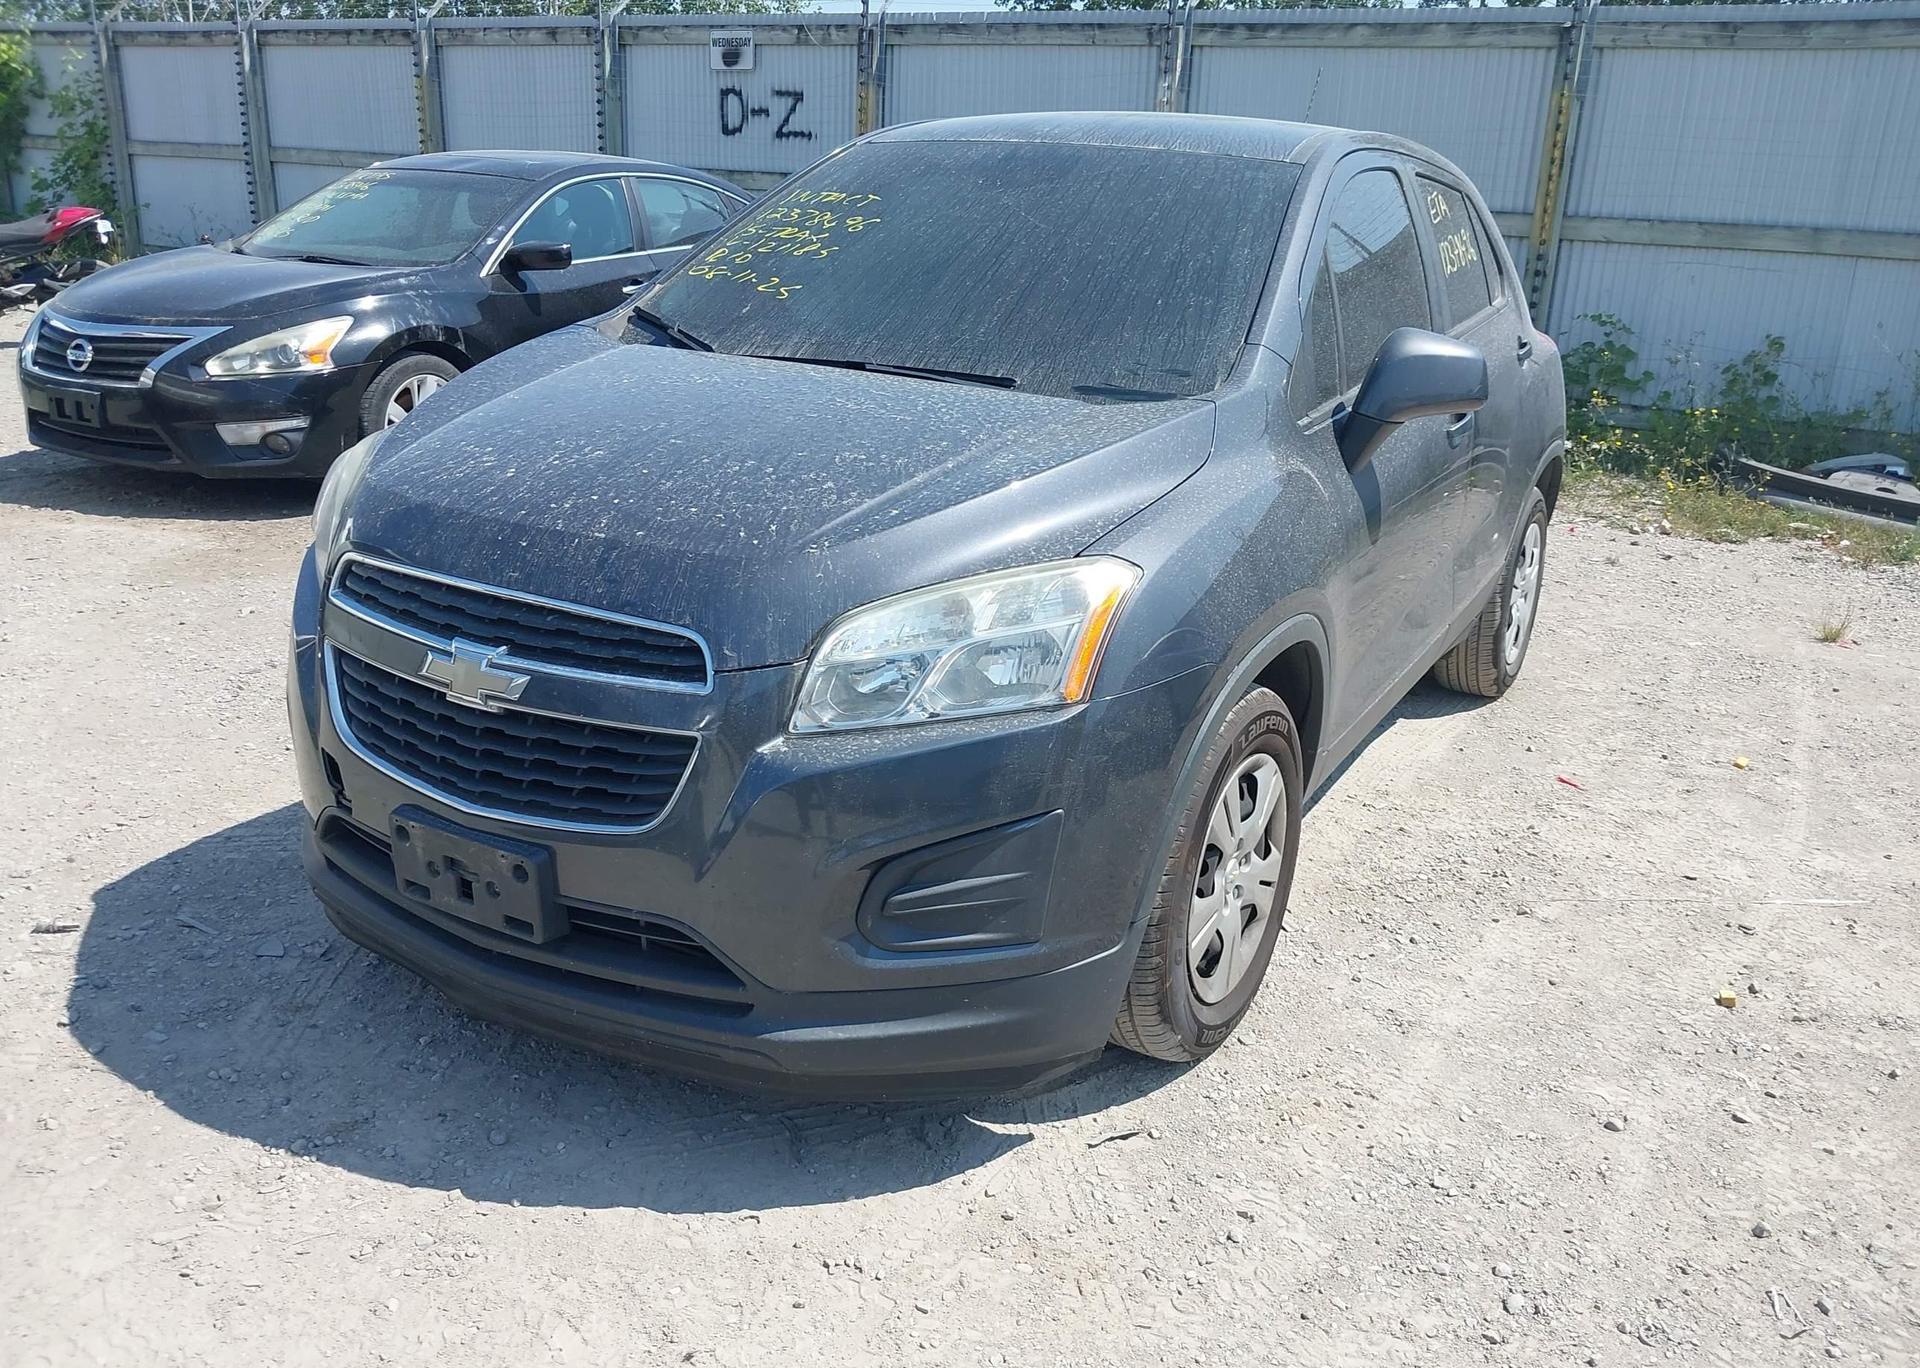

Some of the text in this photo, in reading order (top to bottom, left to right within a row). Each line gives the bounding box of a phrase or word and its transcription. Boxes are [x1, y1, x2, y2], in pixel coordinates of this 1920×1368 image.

[711, 37, 752, 48] WEDNESDAY
[720, 86, 812, 141] D-Z
[779, 189, 882, 207] INTACT
